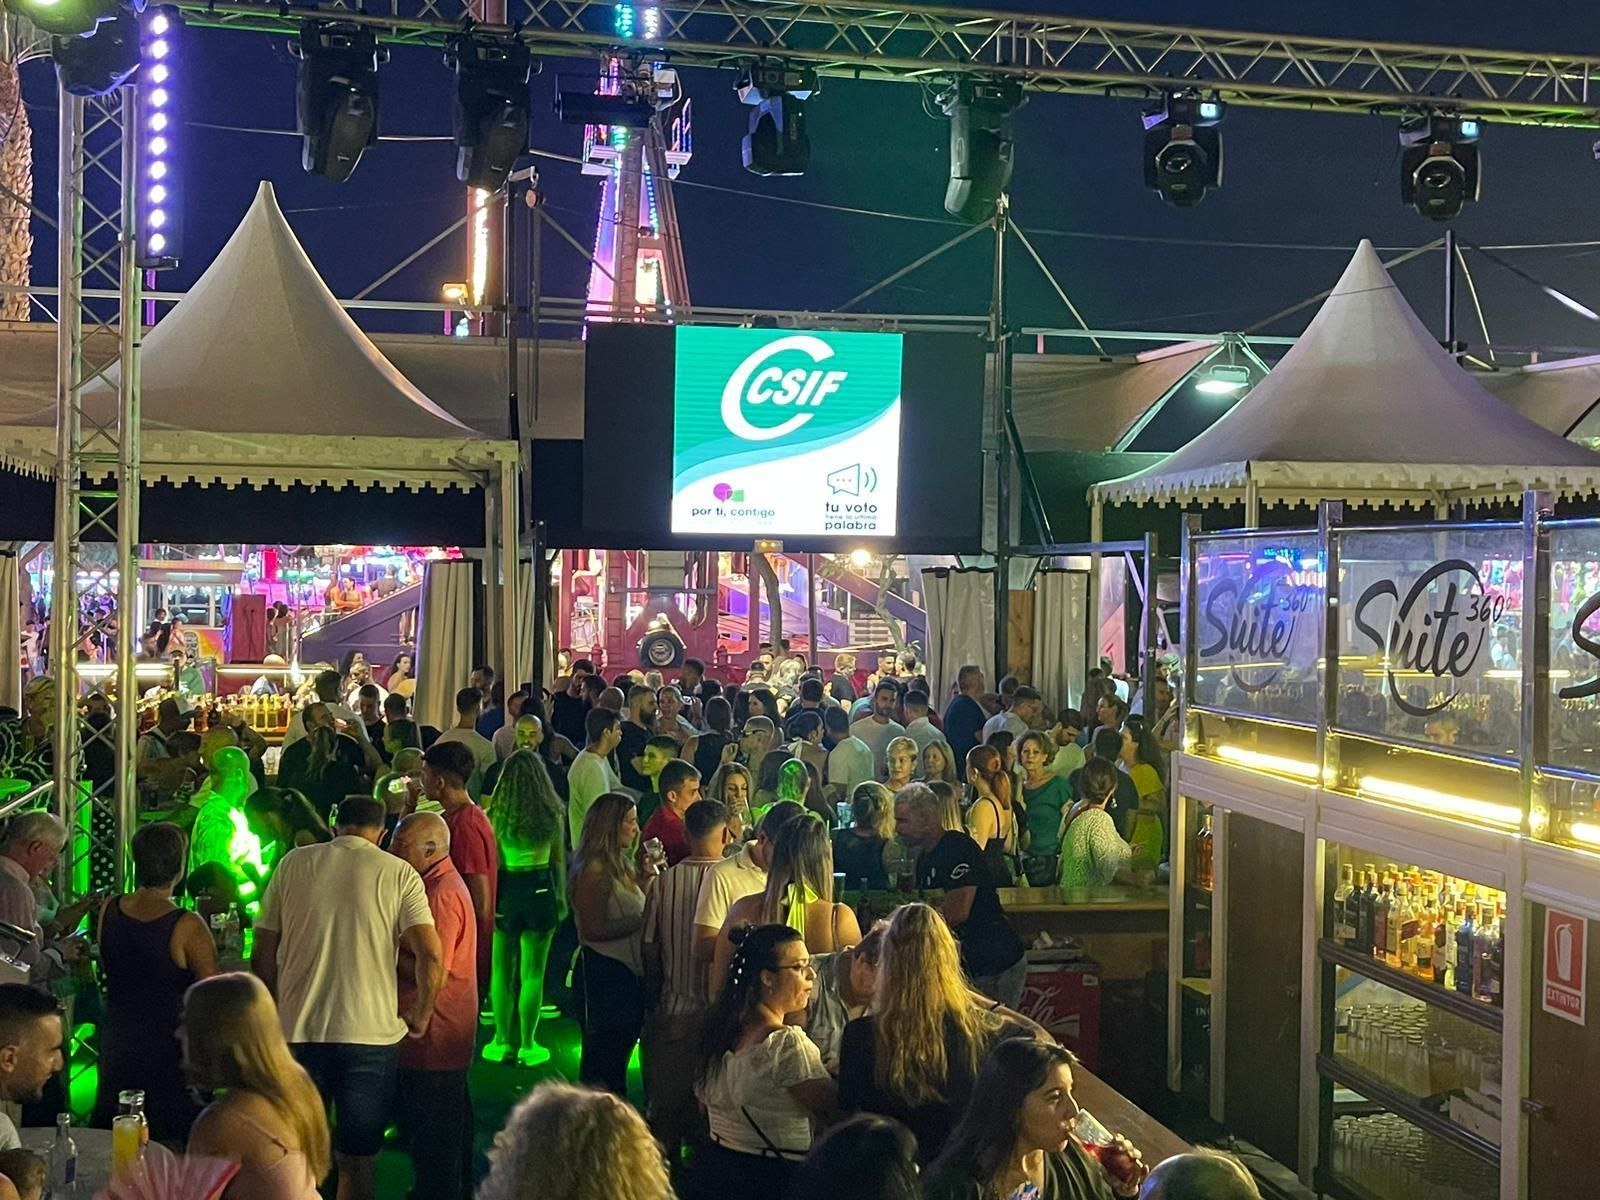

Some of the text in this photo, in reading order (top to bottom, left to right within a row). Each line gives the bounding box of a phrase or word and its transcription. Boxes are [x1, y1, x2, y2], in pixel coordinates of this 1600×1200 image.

[746, 366, 848, 406] CSIF
[691, 506, 775, 519] por ti, contigo
[825, 501, 878, 513] tu voto
[824, 521, 877, 531] palabra
[1200, 578, 1296, 659] Suite
[1353, 578, 1486, 678] Suite
